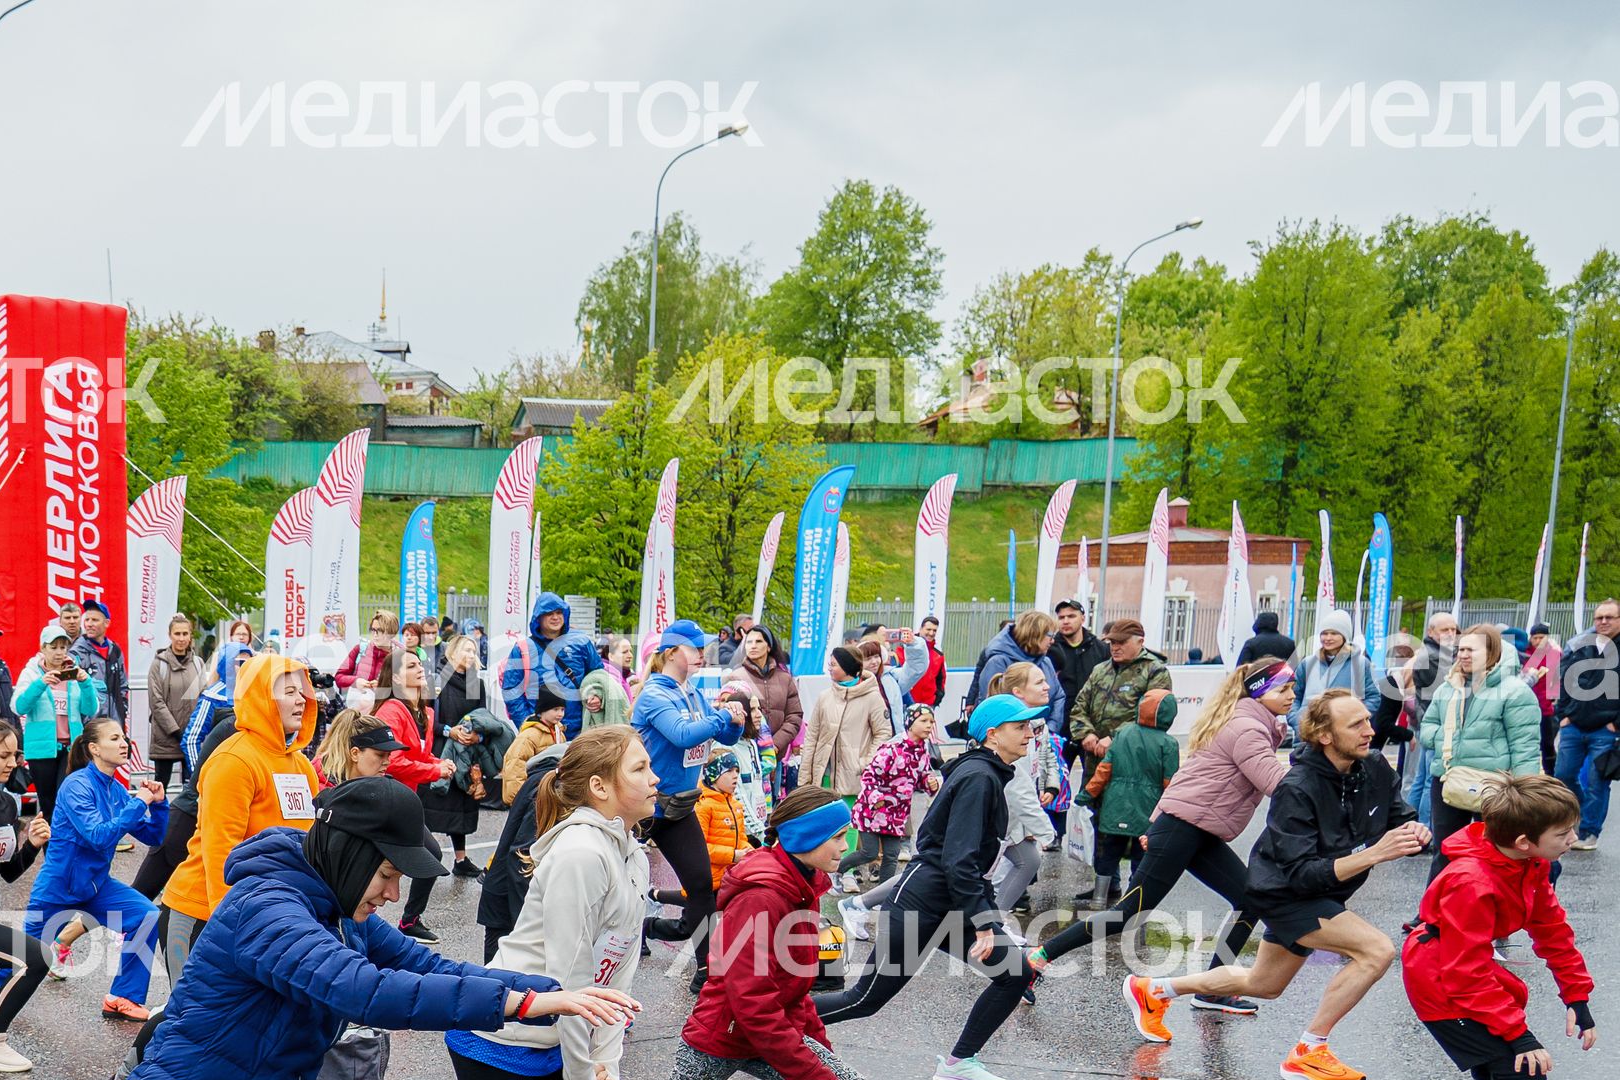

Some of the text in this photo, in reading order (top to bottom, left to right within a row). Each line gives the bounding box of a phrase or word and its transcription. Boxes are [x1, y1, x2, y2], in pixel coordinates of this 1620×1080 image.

[44, 362, 75, 625] УПЕРЛИГА
[77, 363, 100, 602] ДМОСКОВЬЯ
[140, 554, 152, 623] СУПЕРЛИГА
[296, 583, 306, 637] СПОРТ
[55, 700, 67, 711] 212
[285, 792, 306, 812] 3167
